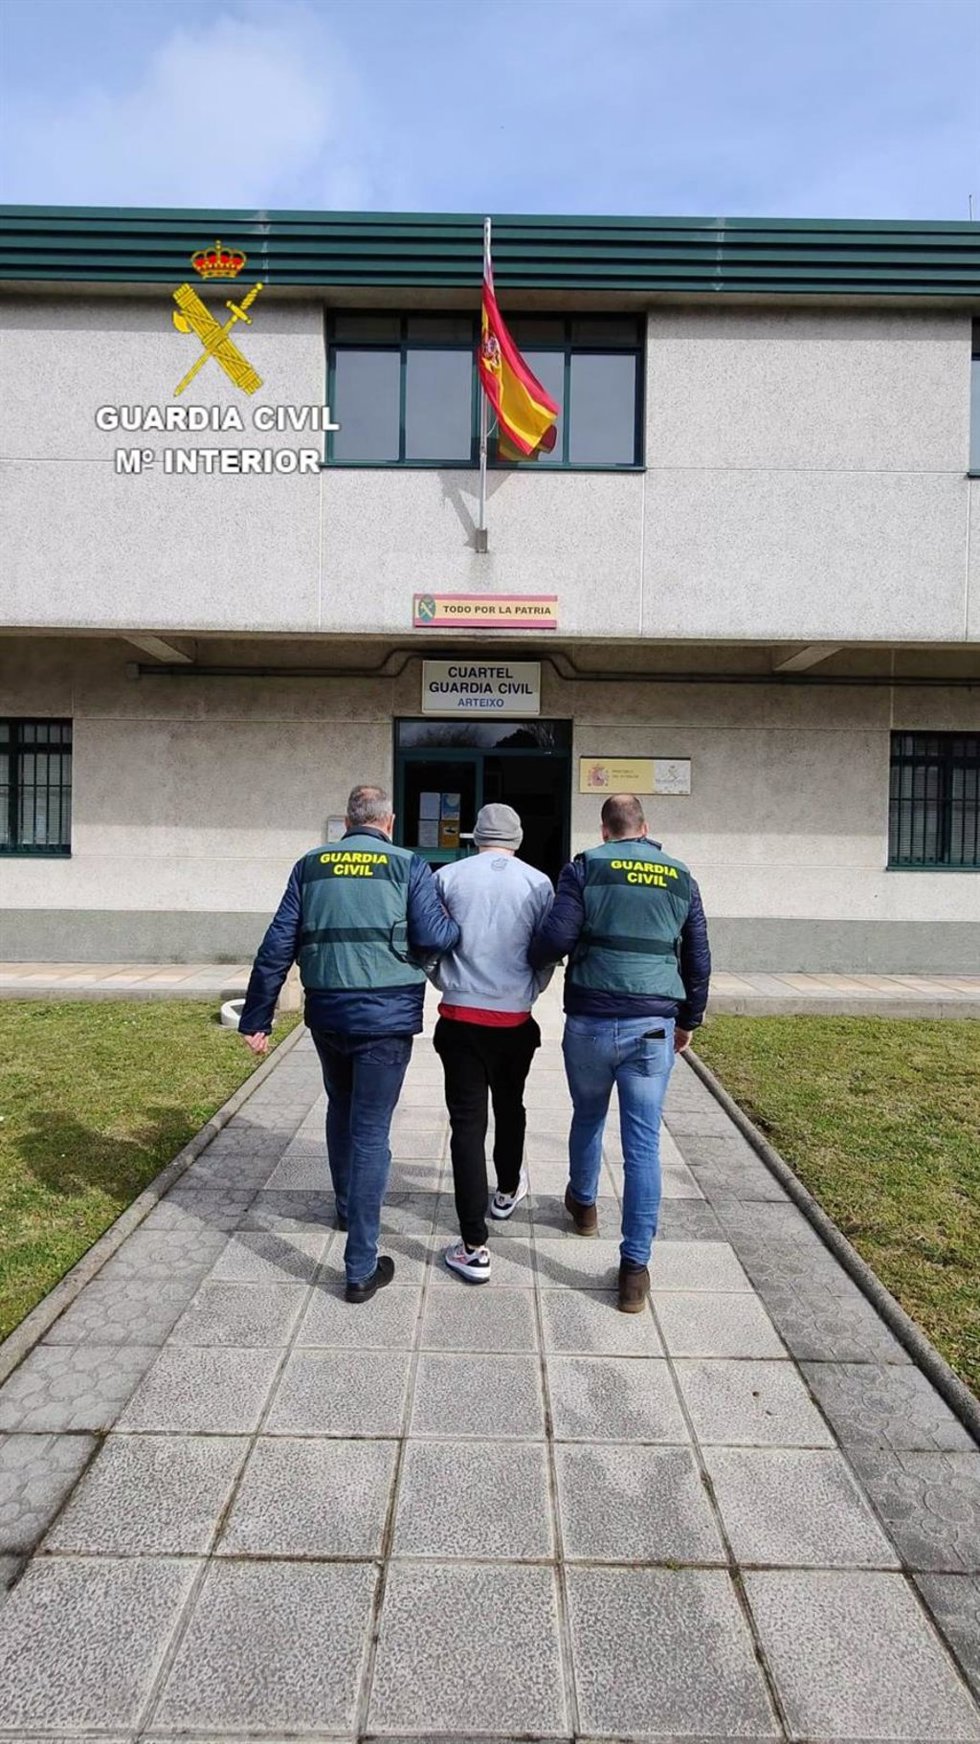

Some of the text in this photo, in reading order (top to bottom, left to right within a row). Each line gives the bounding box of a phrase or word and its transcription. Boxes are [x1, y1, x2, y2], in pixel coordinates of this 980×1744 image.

[443, 605, 551, 615] TODO POR LA PATRIA
[448, 667, 513, 679] CUARTEL
[429, 682, 533, 695] GUARDIA CIVIL
[457, 698, 504, 708] ARTEIXO
[320, 852, 387, 864] GUARDIA
[333, 864, 373, 876] CIVIL
[611, 860, 678, 879] GUARDIA
[627, 872, 667, 887] CIVIL
